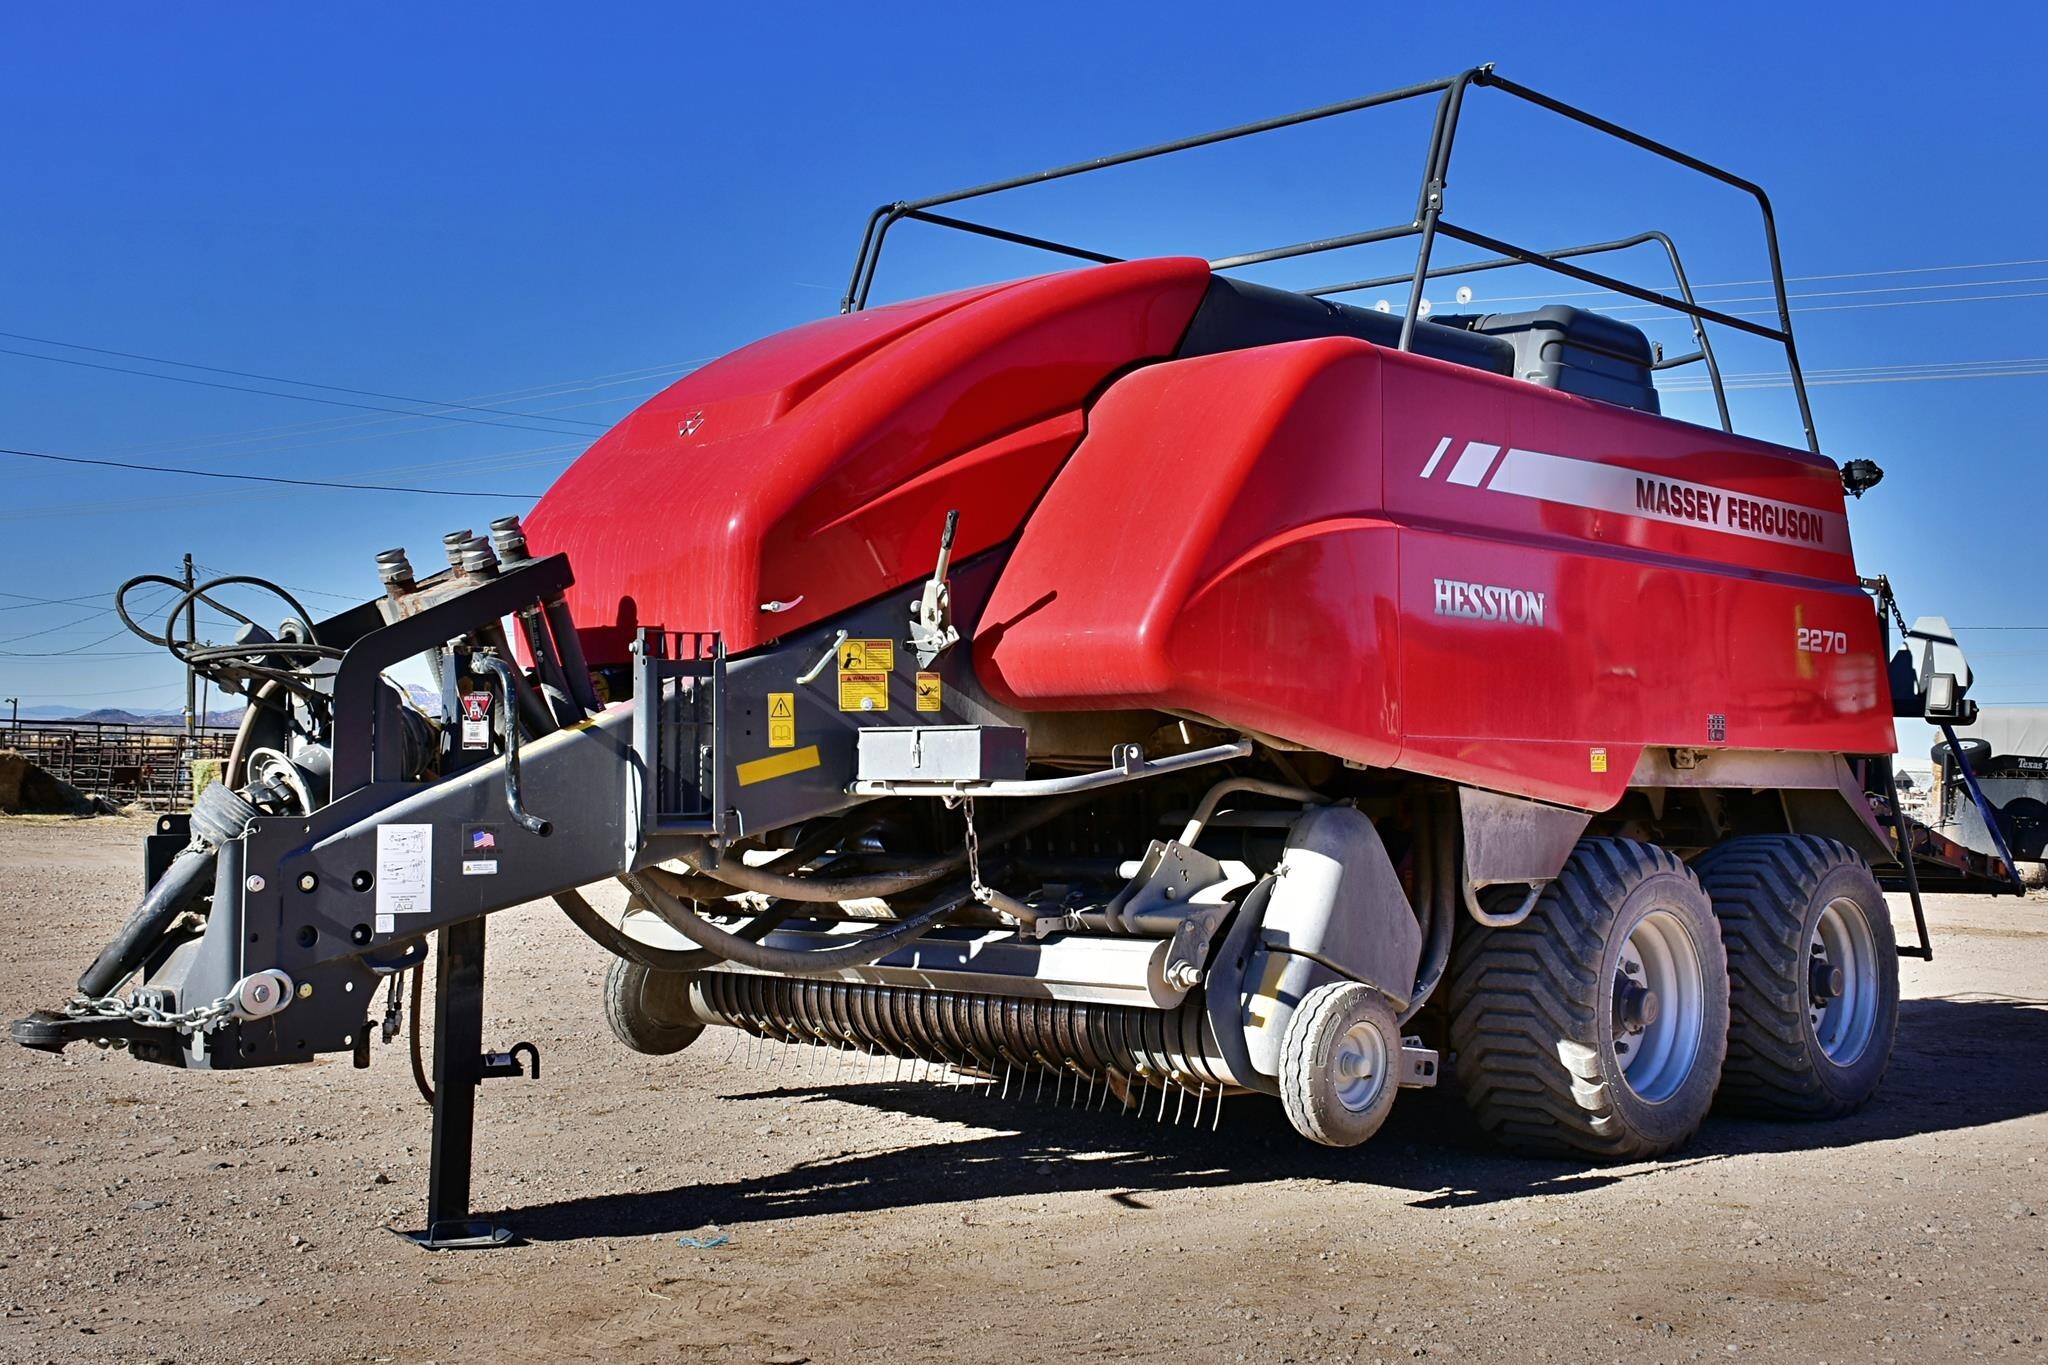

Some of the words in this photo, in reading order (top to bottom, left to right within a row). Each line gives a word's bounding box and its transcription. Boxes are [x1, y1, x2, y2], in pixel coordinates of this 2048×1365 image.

[1636, 478, 1721, 525] MASSEY
[1728, 497, 1824, 544] FERGUSON
[1434, 578, 1545, 627] HESSTON
[1797, 627, 1847, 655] 2270
[2018, 757, 2043, 769] Texas
